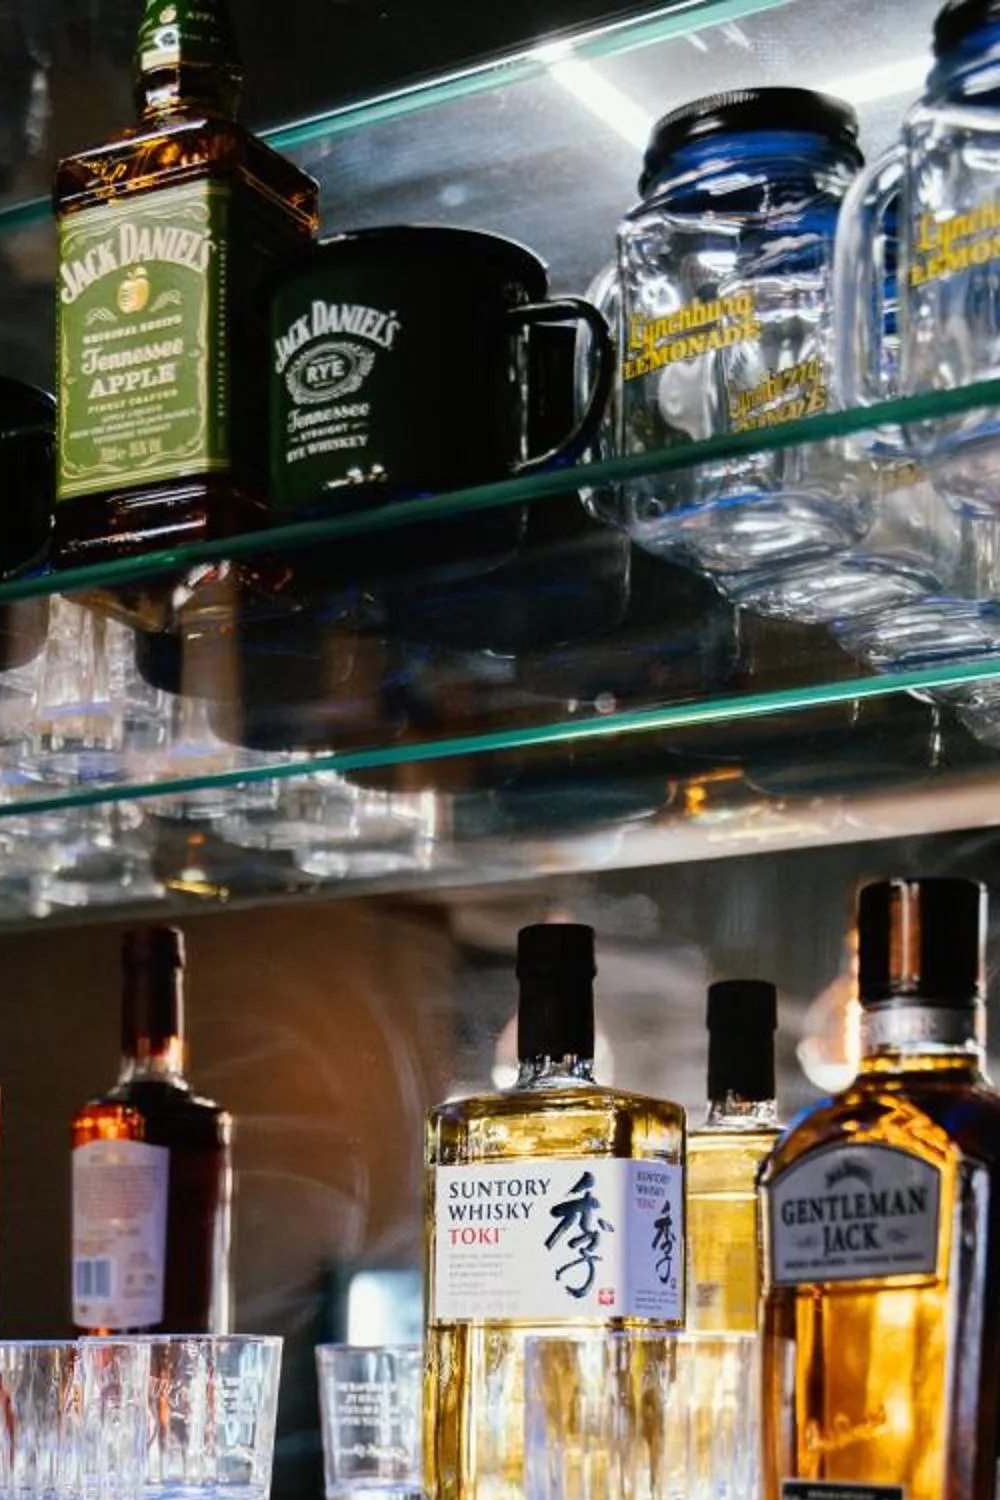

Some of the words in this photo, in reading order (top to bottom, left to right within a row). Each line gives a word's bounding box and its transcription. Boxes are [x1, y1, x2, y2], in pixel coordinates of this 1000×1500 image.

[60, 239, 117, 304] JACK
[119, 222, 216, 274] DANIEL'S
[274, 314, 312, 374] JACK
[312, 299, 401, 350] DANIEL'S
[629, 290, 755, 348] Lynchburg
[81, 338, 184, 376] Tennessee
[624, 322, 761, 381] LEMONADE
[87, 363, 177, 399] APPLE
[306, 360, 346, 384] RYE
[449, 1177, 552, 1199] SUNTORY
[781, 1186, 927, 1227] GENTLEMAN
[449, 1202, 535, 1222] WHISKY
[449, 1228, 502, 1246] TOKI
[824, 1223, 882, 1259] JACK
